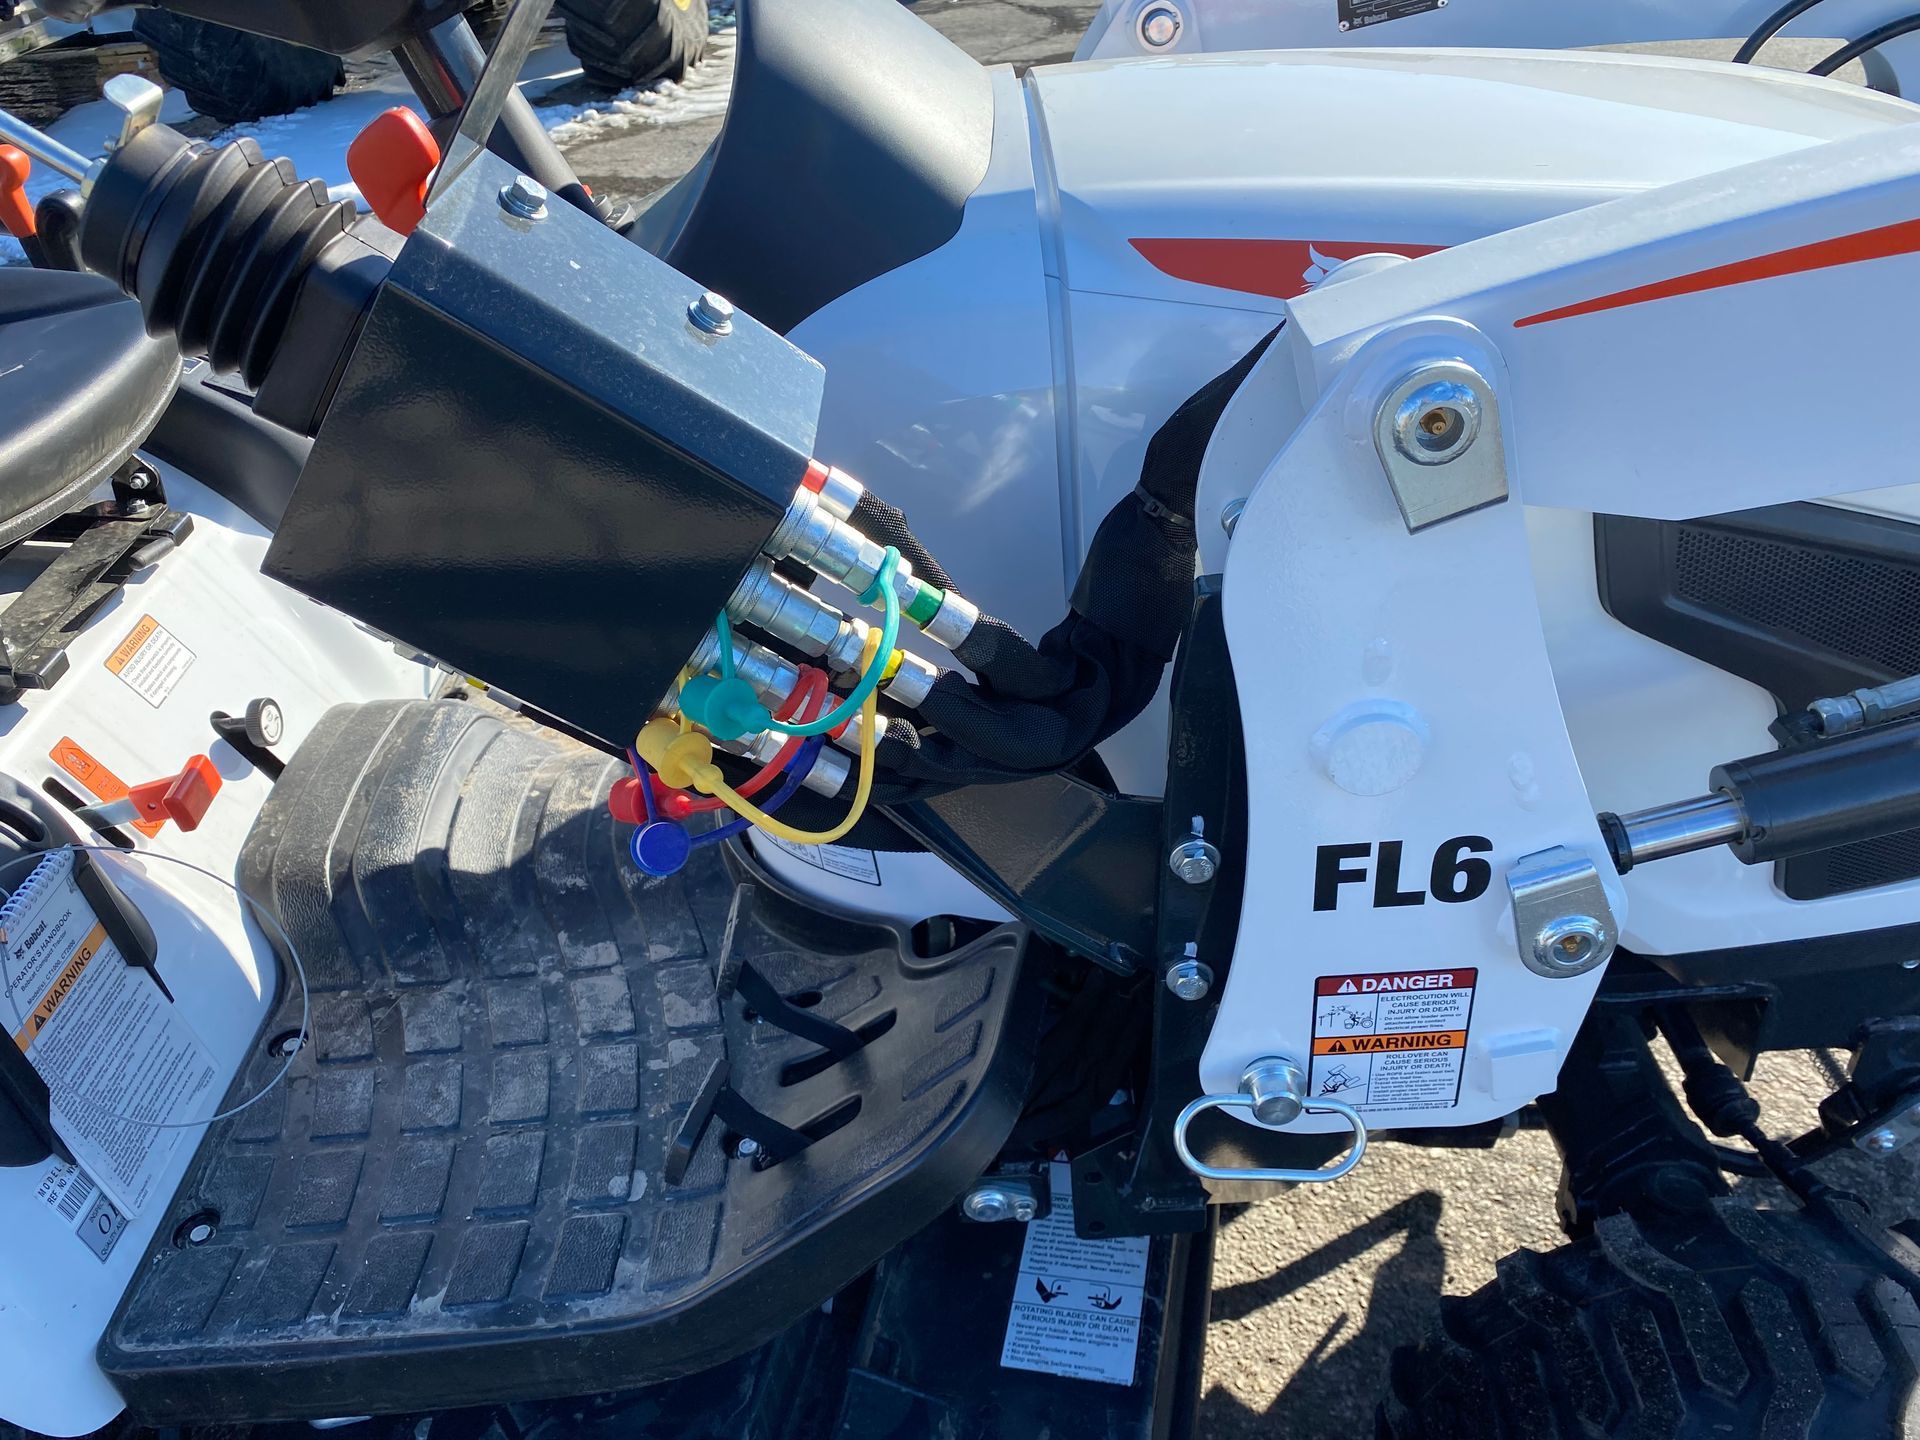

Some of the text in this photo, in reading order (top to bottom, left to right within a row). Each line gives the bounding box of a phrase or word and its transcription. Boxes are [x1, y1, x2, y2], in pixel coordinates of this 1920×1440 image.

[119, 623, 151, 658] WARNING
[1313, 835, 1493, 912] FL6
[24, 920, 47, 951] Bobcat
[3, 908, 72, 999] OPERATOR'S HANDBOOK
[20, 929, 67, 992] Bobcat Compact Tractor
[43, 946, 92, 1014] WARNING
[1361, 973, 1454, 992] DANGER
[1380, 992, 1448, 1001] ELECTROCUTION
[1351, 1033, 1451, 1050] WARNING
[37, 1166, 62, 1198] MODEL
[101, 1231, 118, 1256] QUALITY
[1014, 1303, 1136, 1327] ROTATING BLADES CAN CAUSE
[1021, 1312, 1129, 1334] SERIOUS INJURY OR DEATH
